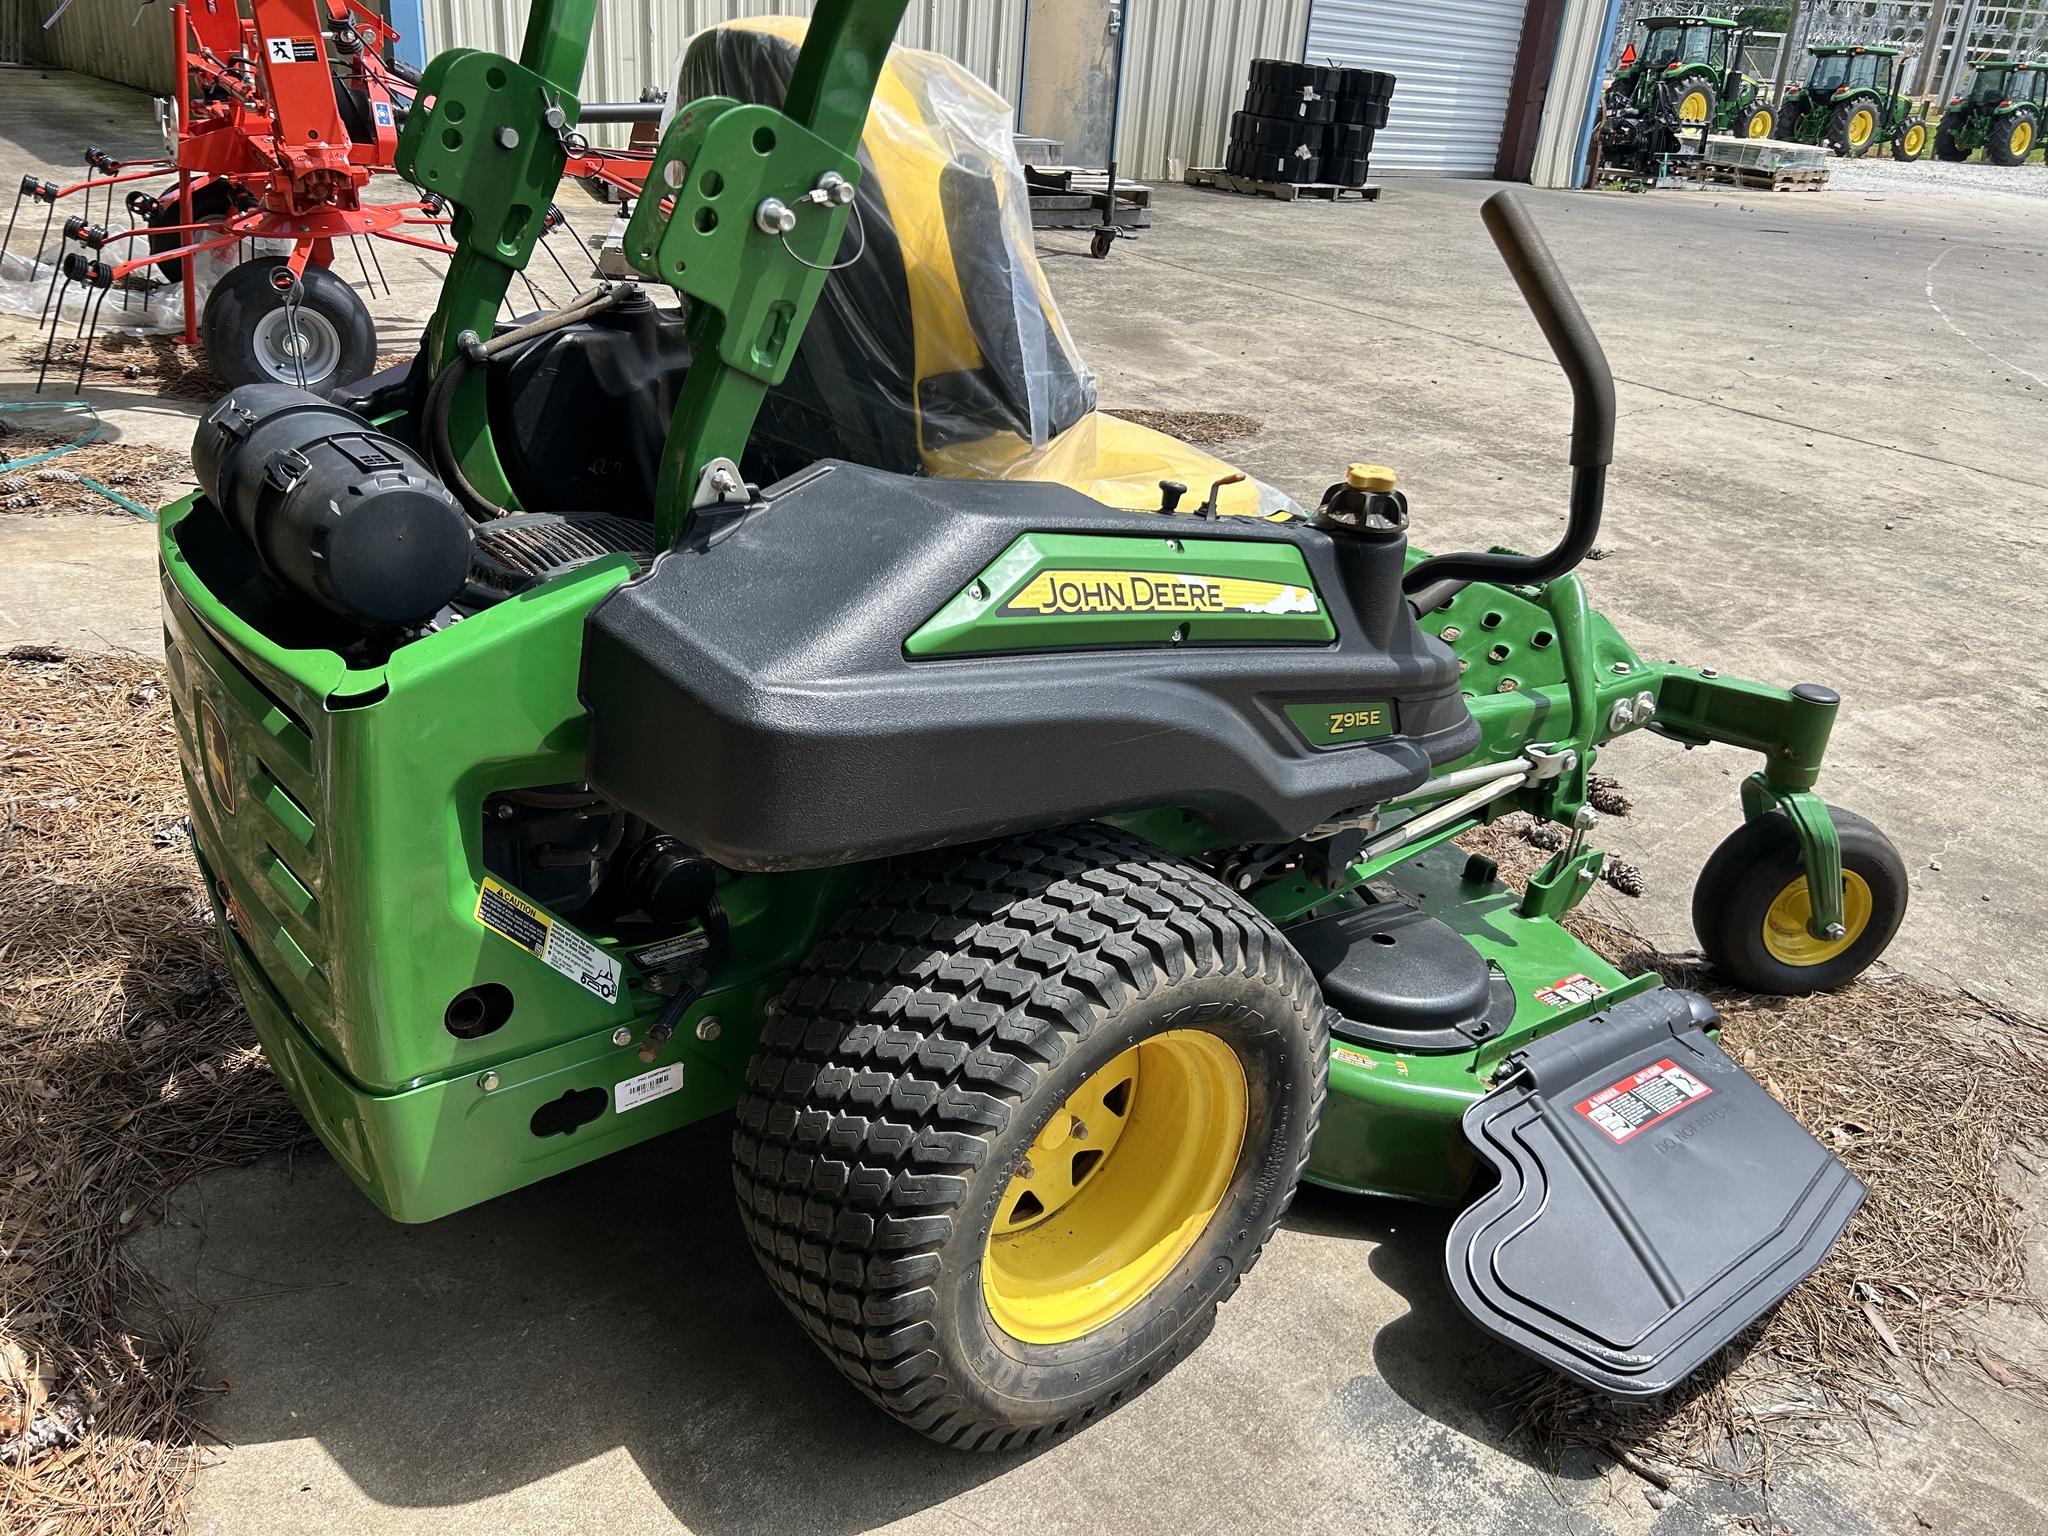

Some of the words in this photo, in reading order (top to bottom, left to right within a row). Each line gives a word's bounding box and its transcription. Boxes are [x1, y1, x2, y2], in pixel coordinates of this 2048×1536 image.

[1042, 577, 1126, 608] JOHN
[1130, 577, 1223, 607] DEERE
[1330, 710, 1381, 734] Z915E
[504, 892, 537, 918] CAUTION
[1655, 1138, 1676, 1154] DO
[1674, 1124, 1699, 1142] NOT
